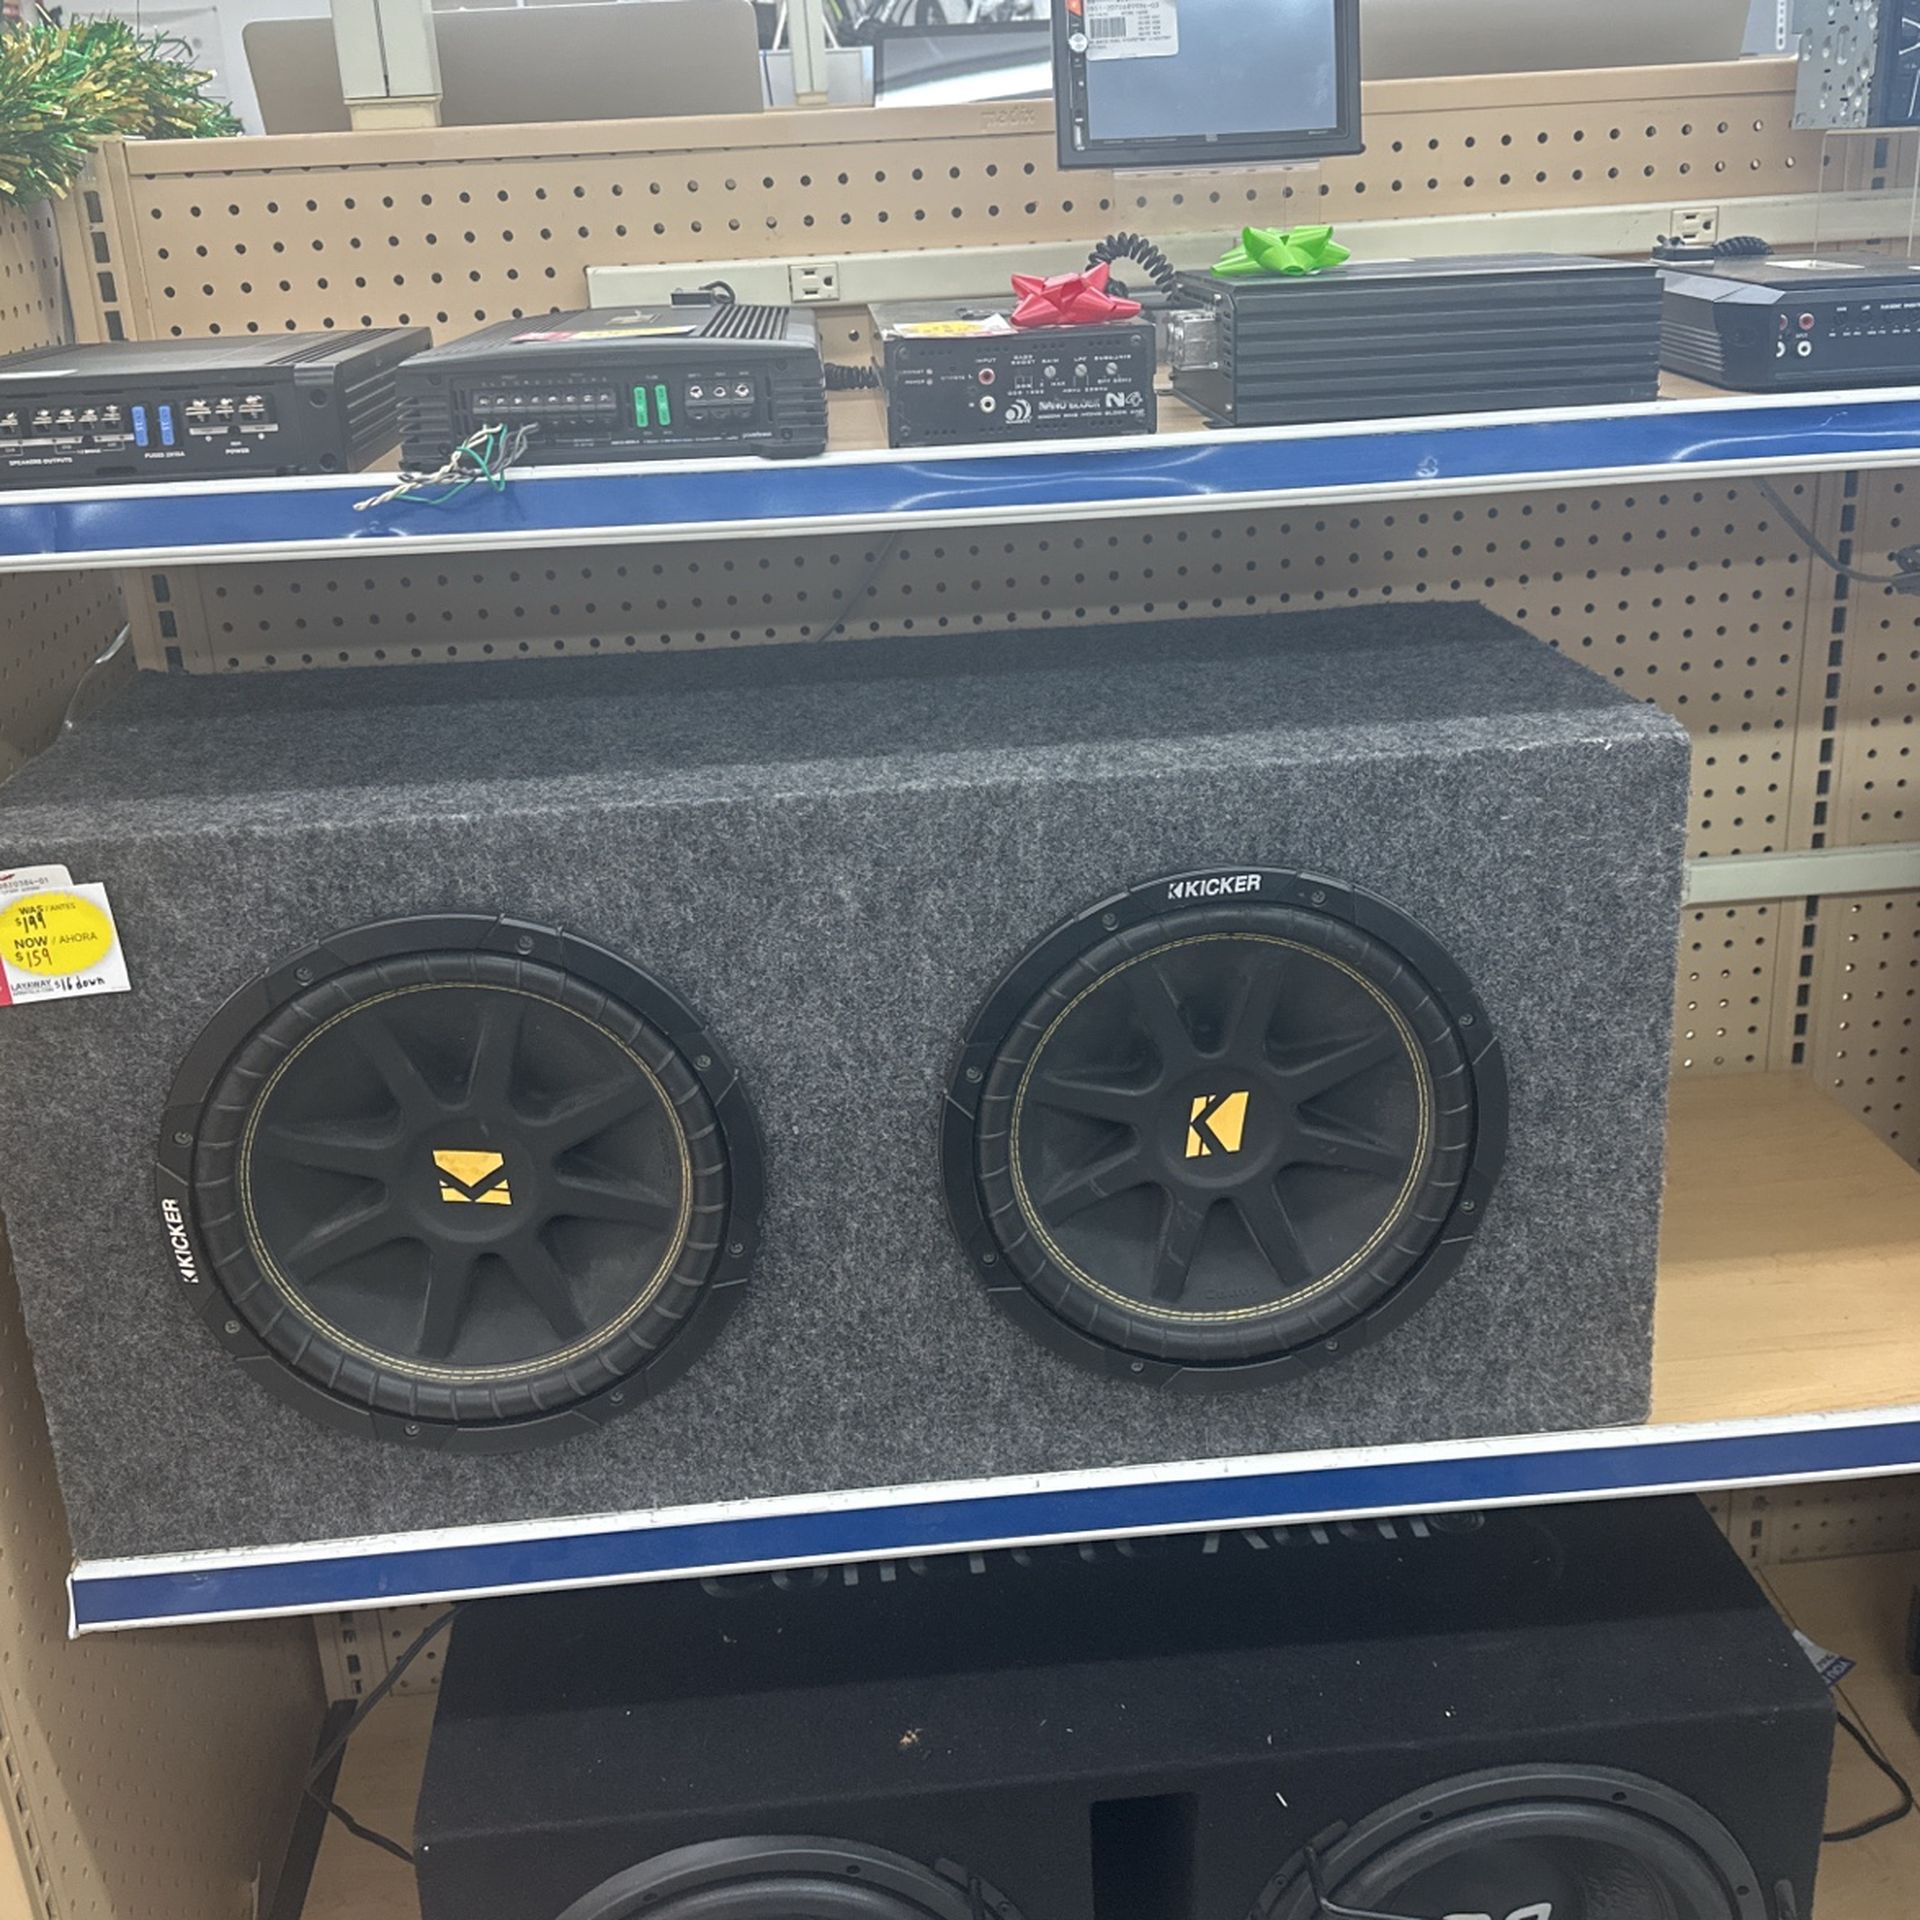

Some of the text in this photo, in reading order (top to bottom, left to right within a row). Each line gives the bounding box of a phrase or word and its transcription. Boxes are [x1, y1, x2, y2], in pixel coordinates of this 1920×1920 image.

[1184, 874, 1262, 899] KICKER
[19, 905, 44, 914] WAS
[50, 902, 76, 911] ANTES
[14, 936, 48, 949] NOW
[59, 932, 98, 944] AHORA
[15, 948, 53, 968] $159
[11, 979, 52, 991] LAYAWAY
[76, 976, 105, 990] down
[162, 1199, 195, 1269] KICKER
